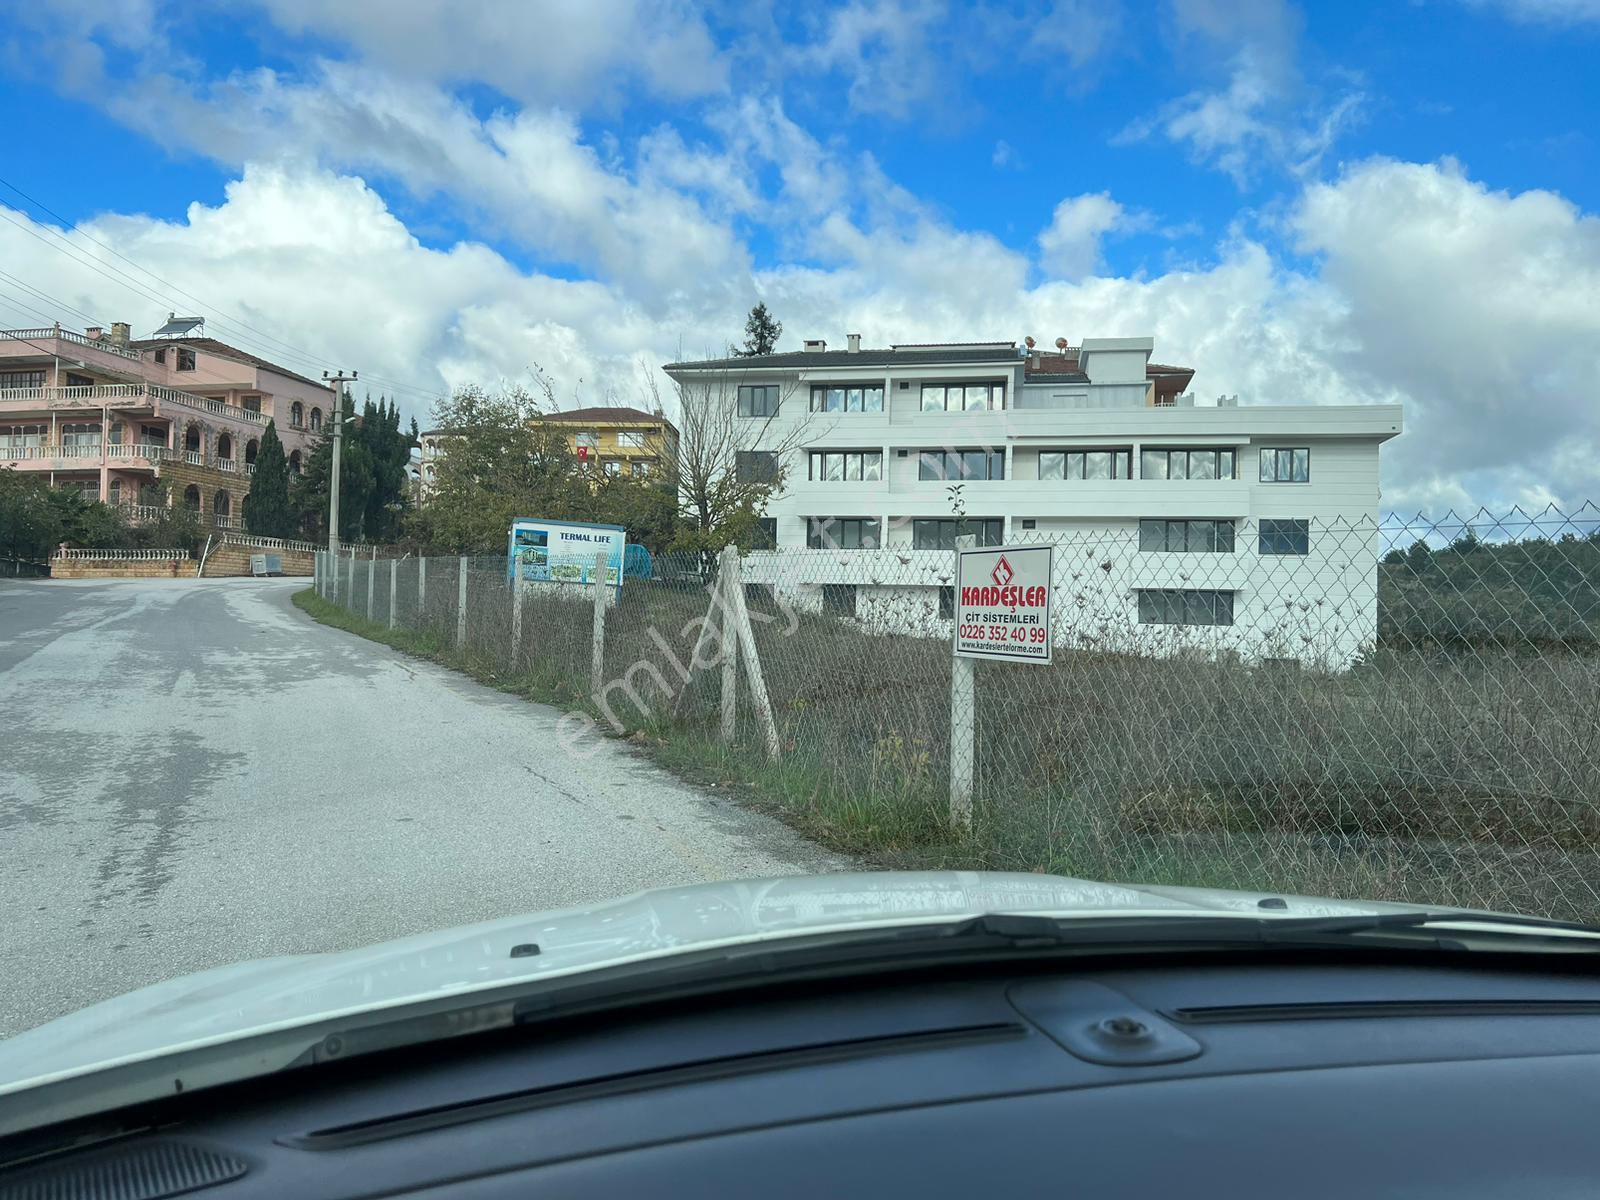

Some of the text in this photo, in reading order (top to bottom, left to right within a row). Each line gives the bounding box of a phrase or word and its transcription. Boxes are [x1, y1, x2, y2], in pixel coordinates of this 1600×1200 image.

[560, 532, 611, 544] TERMAL LIFE
[961, 586, 1046, 613] KARDEŞLER
[965, 612, 1039, 624] ÇİT SİSTEMLERİ
[960, 624, 1045, 643] 0226 352 40 99
